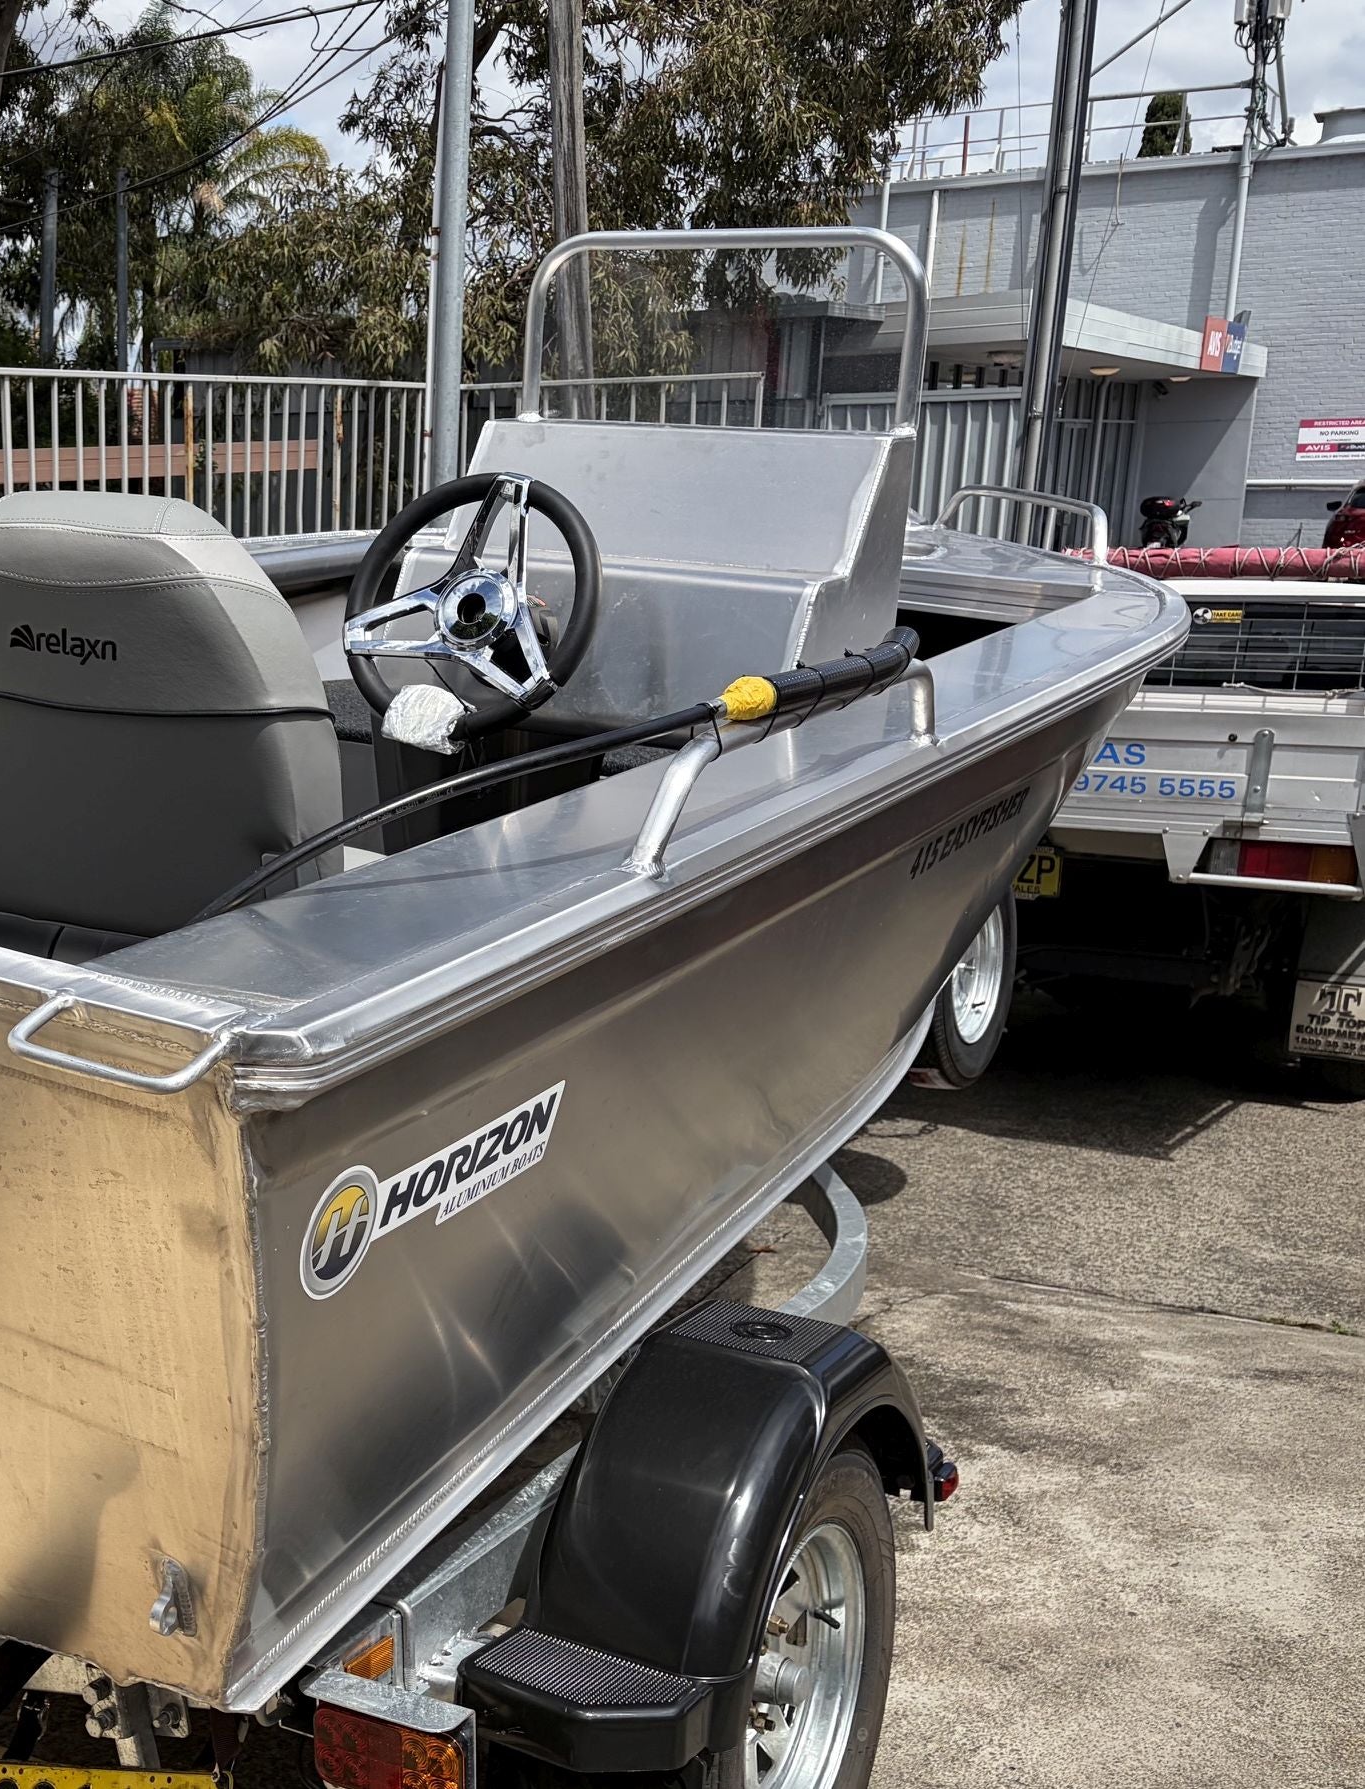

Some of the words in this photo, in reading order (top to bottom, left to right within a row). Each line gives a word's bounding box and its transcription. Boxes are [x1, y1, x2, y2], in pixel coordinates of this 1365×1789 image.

[35, 628, 118, 666] relaxn
[1093, 742, 1146, 765] AS
[1073, 774, 1147, 795] 9745
[1158, 777, 1236, 799] 5555
[909, 836, 944, 880] 415
[938, 786, 1031, 862] EASYFISHER
[1307, 1013, 1331, 1026] TIP
[1337, 1017, 1365, 1030] TOP
[379, 1092, 558, 1229] HORIZON
[439, 1164, 511, 1219] ALUMINIUM
[510, 1140, 546, 1175] BOATS
